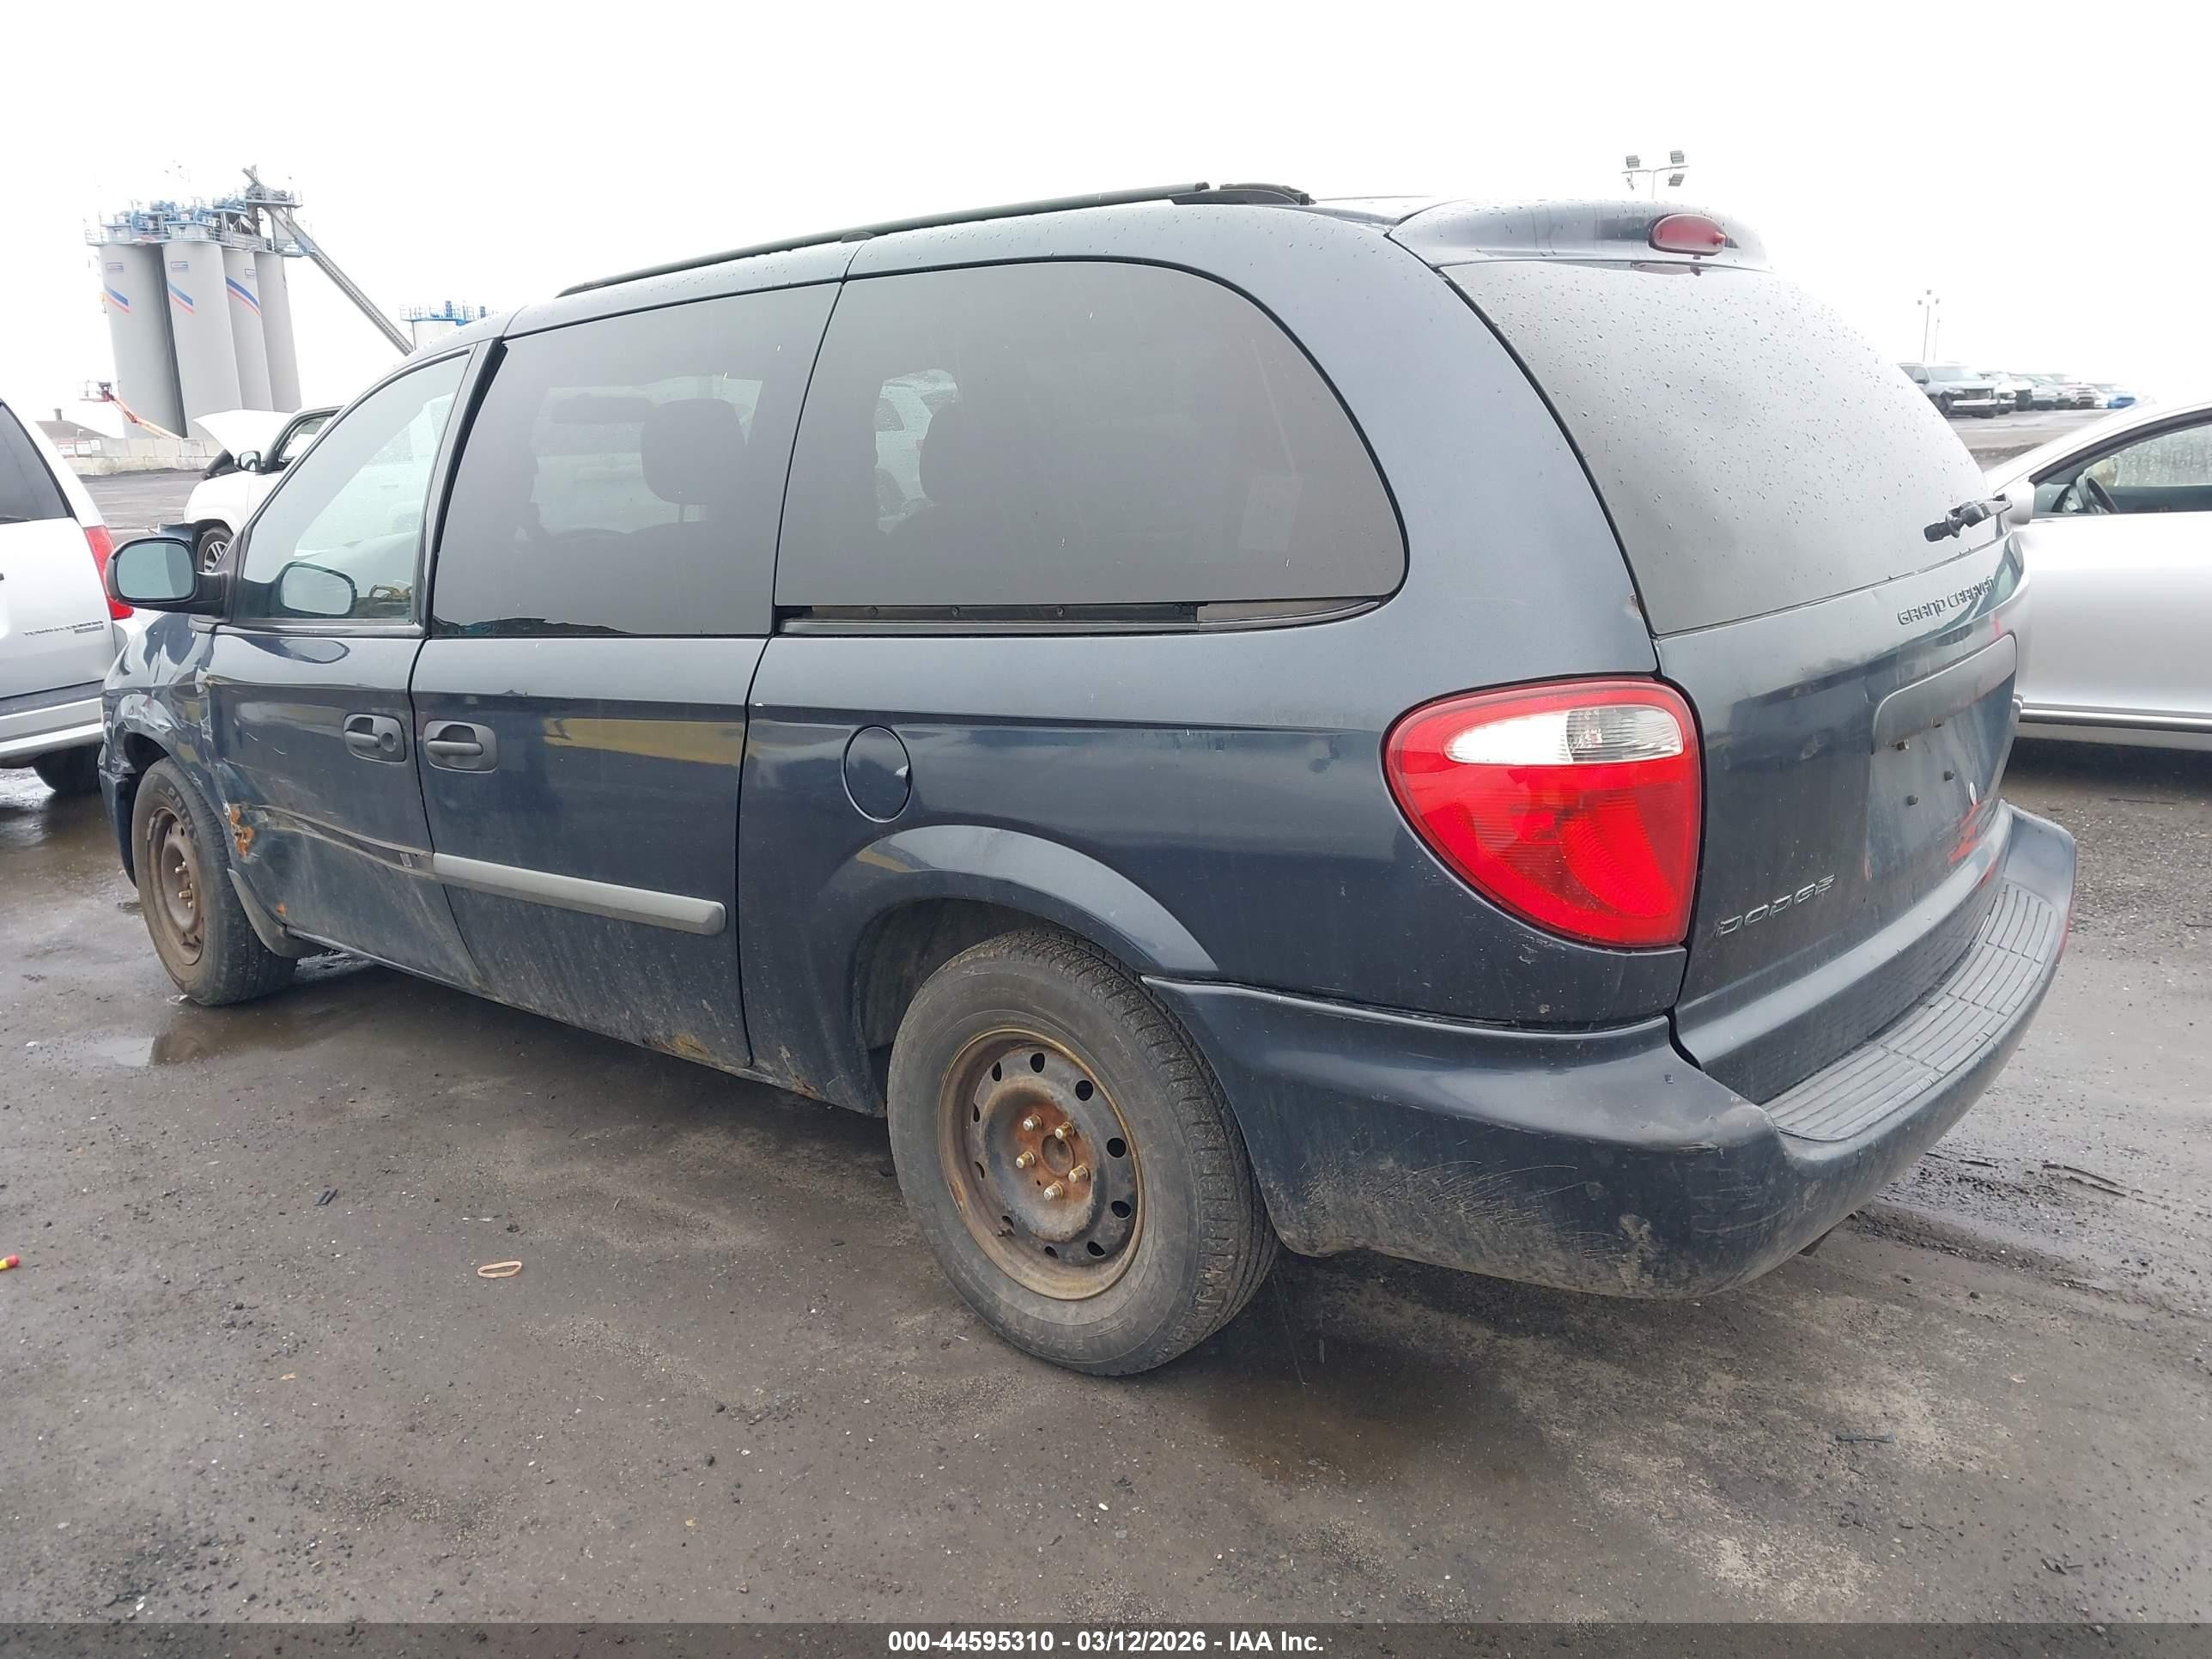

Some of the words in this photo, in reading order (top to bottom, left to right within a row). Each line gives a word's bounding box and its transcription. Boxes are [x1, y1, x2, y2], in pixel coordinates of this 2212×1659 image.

[1896, 599, 1947, 626] GRAND
[1947, 575, 1996, 609] CARAVAN
[1715, 873, 1836, 938] DODGE
